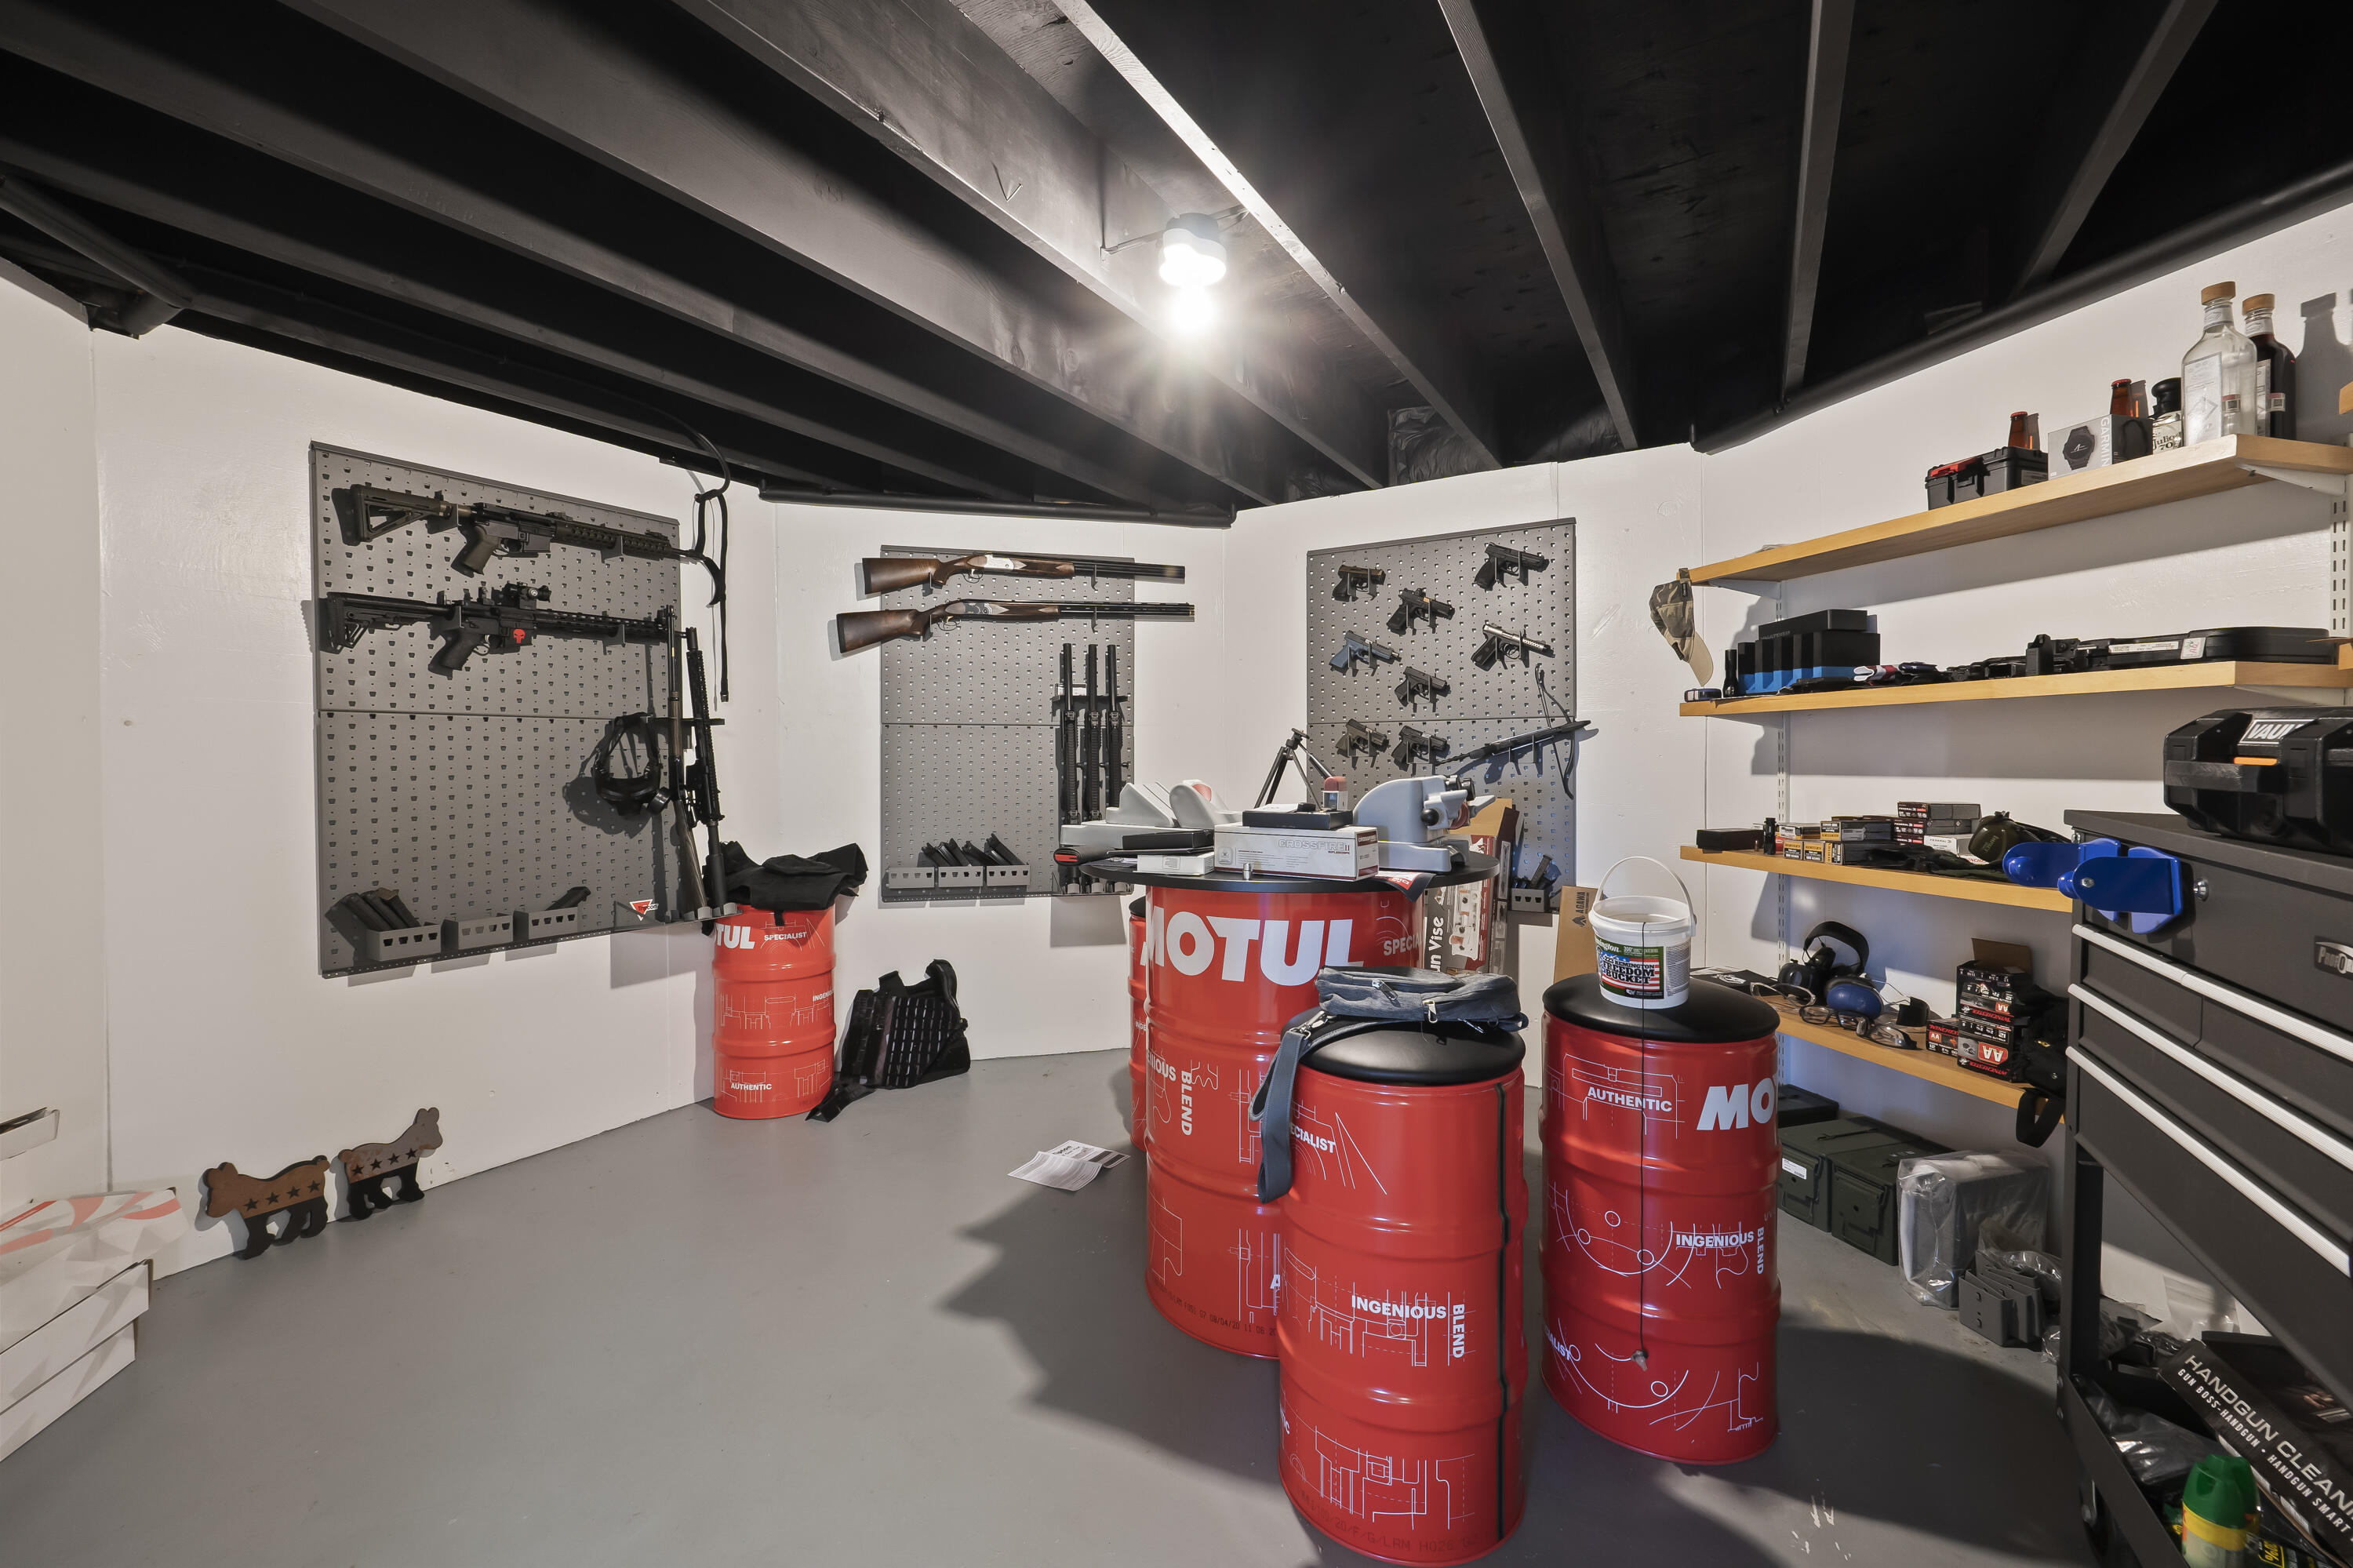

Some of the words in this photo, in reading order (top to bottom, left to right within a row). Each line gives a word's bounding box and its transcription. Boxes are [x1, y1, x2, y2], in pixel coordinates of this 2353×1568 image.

[2100, 417, 2110, 467] GARMIN
[2246, 723, 2304, 740] VAUL
[1278, 839, 1345, 852] CROSSFIRE
[1576, 891, 1585, 914] AGAWA
[764, 931, 807, 941] SPECIALIST
[1428, 916, 1444, 951] Vise
[1430, 954, 1442, 973] un
[1603, 960, 1655, 977] FREEDOM
[1614, 959, 1655, 969] REMINGTON
[1606, 967, 1651, 984] BUCKET
[1972, 1009, 2012, 1023] WINCHESTER
[1998, 1003, 2009, 1013] AA
[1981, 1045, 2005, 1063] AA
[1969, 1060, 2008, 1076] WINCHESTER
[730, 1082, 773, 1091] AUTHENTIC
[1180, 1069, 1193, 1137] BLEND
[1587, 1086, 1673, 1112] AUTHENTIC
[1675, 1231, 1755, 1248] INGENIOUS
[1351, 1294, 1448, 1320] INGENIOUS
[1452, 1303, 1465, 1359] BLEND
[2184, 1355, 2279, 1442] HANDGUN
[2177, 1368, 2197, 1387] GUN
[2195, 1385, 2261, 1448] BOSS-HANDGUN
[2267, 1454, 2313, 1498] HANDGUN
[2312, 1497, 2351, 1533] SMART
